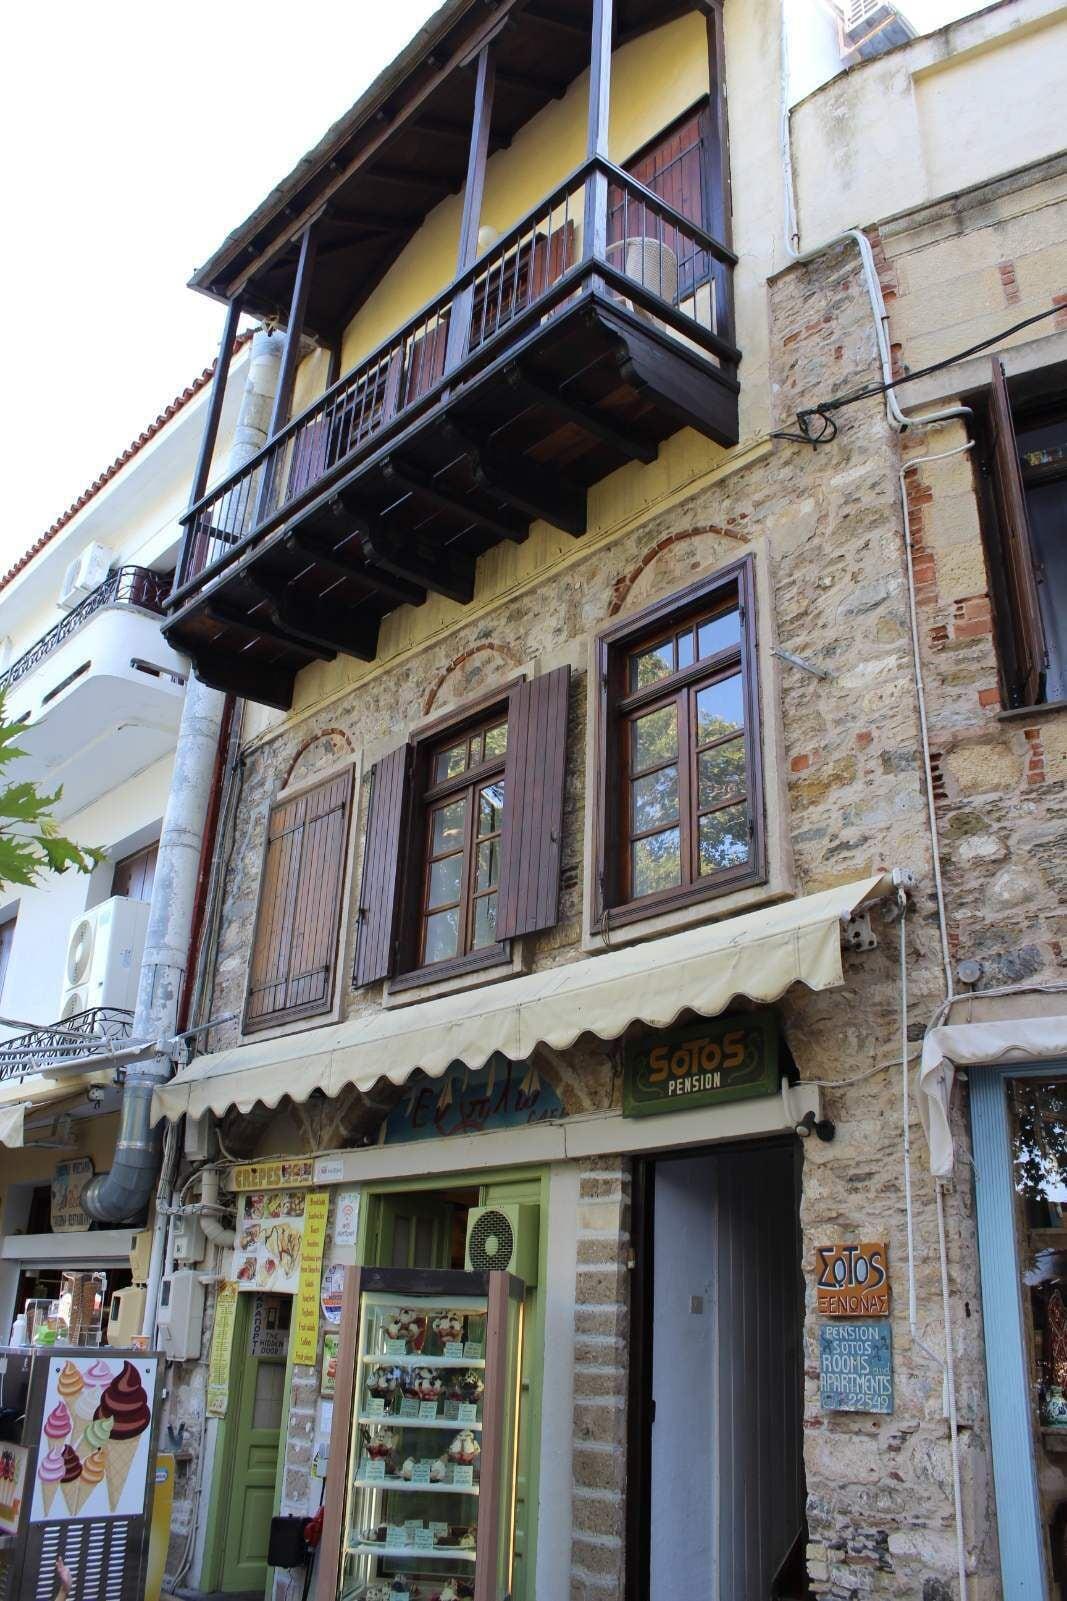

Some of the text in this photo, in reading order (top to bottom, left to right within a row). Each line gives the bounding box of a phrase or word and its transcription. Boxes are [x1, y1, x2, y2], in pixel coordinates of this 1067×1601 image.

[648, 1030, 745, 1083] SOTOS
[668, 1072, 721, 1096] PENSION
[826, 1326, 879, 1340] PENSION
[833, 1340, 872, 1355] SOTOS
[822, 1354, 870, 1374] ROOMS
[820, 1372, 892, 1395] APARTMENTS
[847, 1392, 889, 1411] 22549
